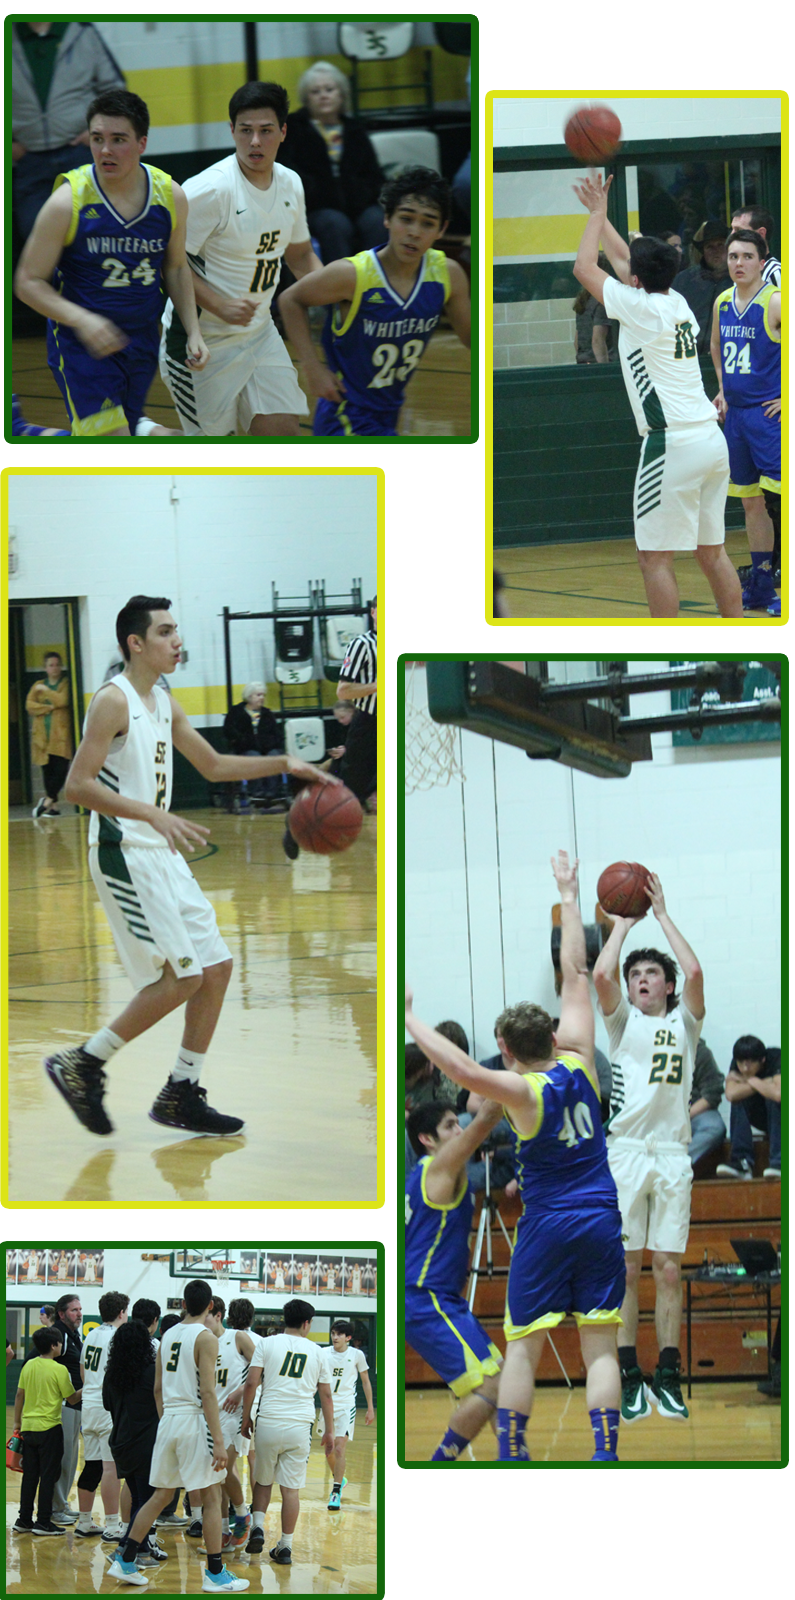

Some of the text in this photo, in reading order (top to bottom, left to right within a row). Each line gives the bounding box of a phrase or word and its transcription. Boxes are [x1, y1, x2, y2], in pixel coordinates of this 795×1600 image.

[86, 237, 164, 254] WHITEFACE
[255, 230, 280, 254] SE
[101, 258, 156, 287] 24
[249, 258, 279, 293] 10
[674, 321, 696, 359] 10
[367, 339, 424, 388] 23
[723, 341, 751, 374] 24
[654, 1029, 677, 1047] SE
[648, 1053, 683, 1085] 23
[558, 1101, 594, 1148] 40
[84, 1345, 102, 1372] 50
[166, 1342, 182, 1372] 3
[279, 1351, 307, 1379] 10
[332, 1367, 344, 1377] SE
[333, 1379, 341, 1393] 1
